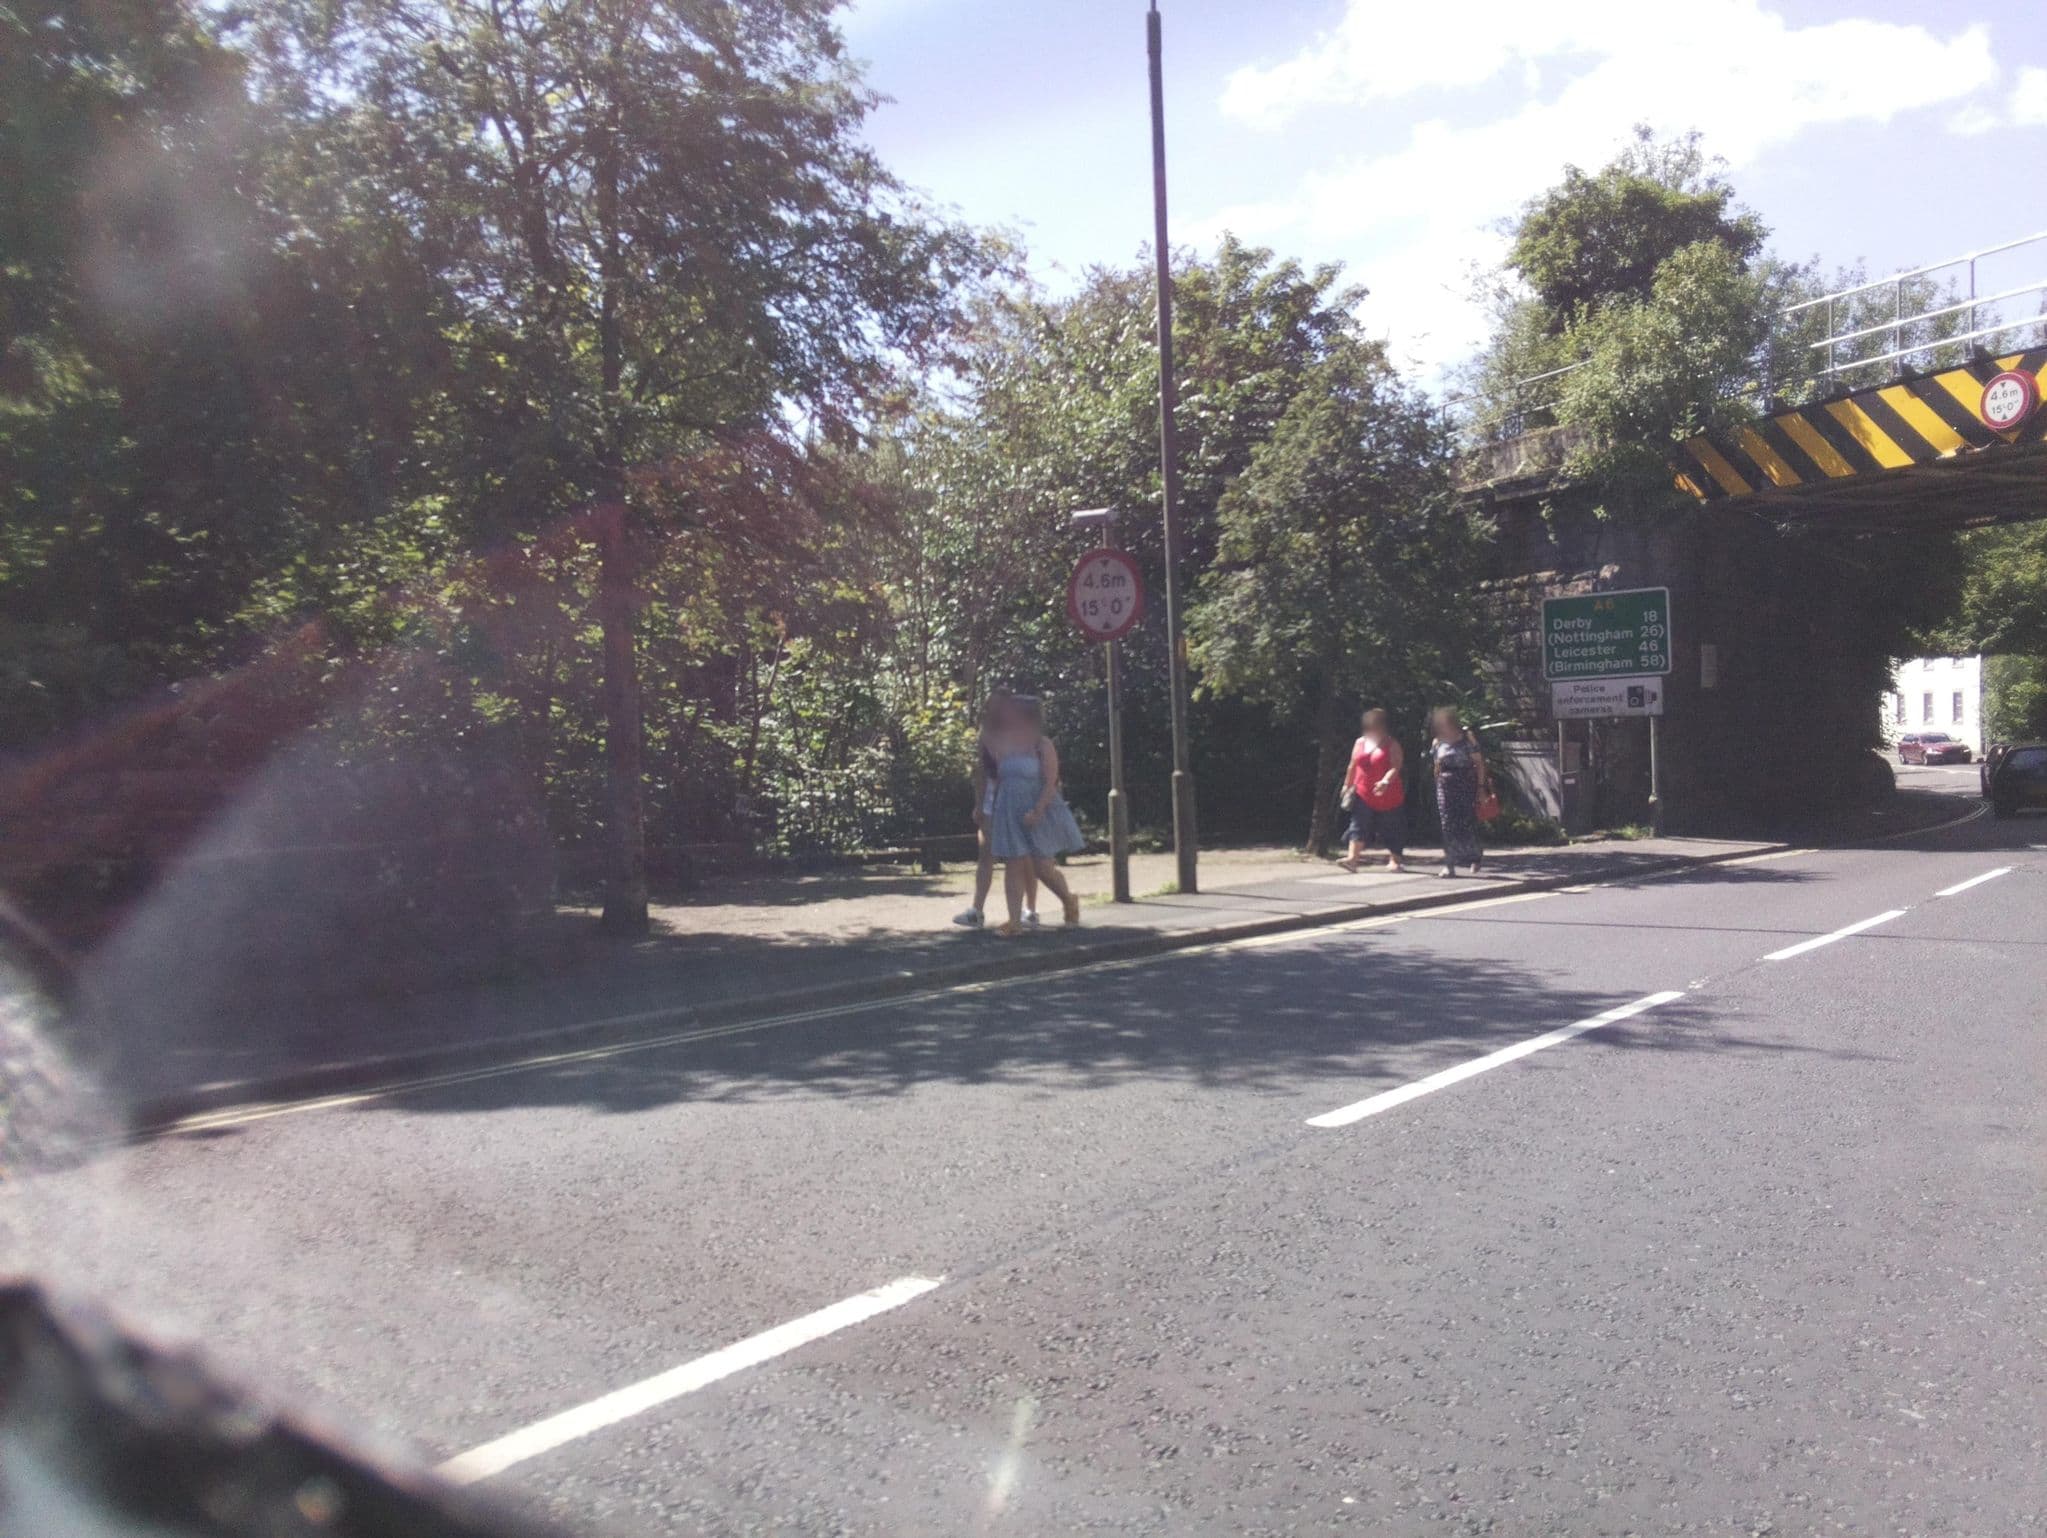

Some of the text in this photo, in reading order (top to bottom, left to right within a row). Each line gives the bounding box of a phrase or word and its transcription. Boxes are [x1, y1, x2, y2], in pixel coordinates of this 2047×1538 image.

[1083, 573, 1126, 588] 4.6m
[1553, 610, 1658, 630] Derby 18
[1548, 625, 1665, 646] (Nottingham 26)
[1554, 640, 1658, 658] Leicester 46
[1549, 655, 1666, 674] (Birmingham 58)
